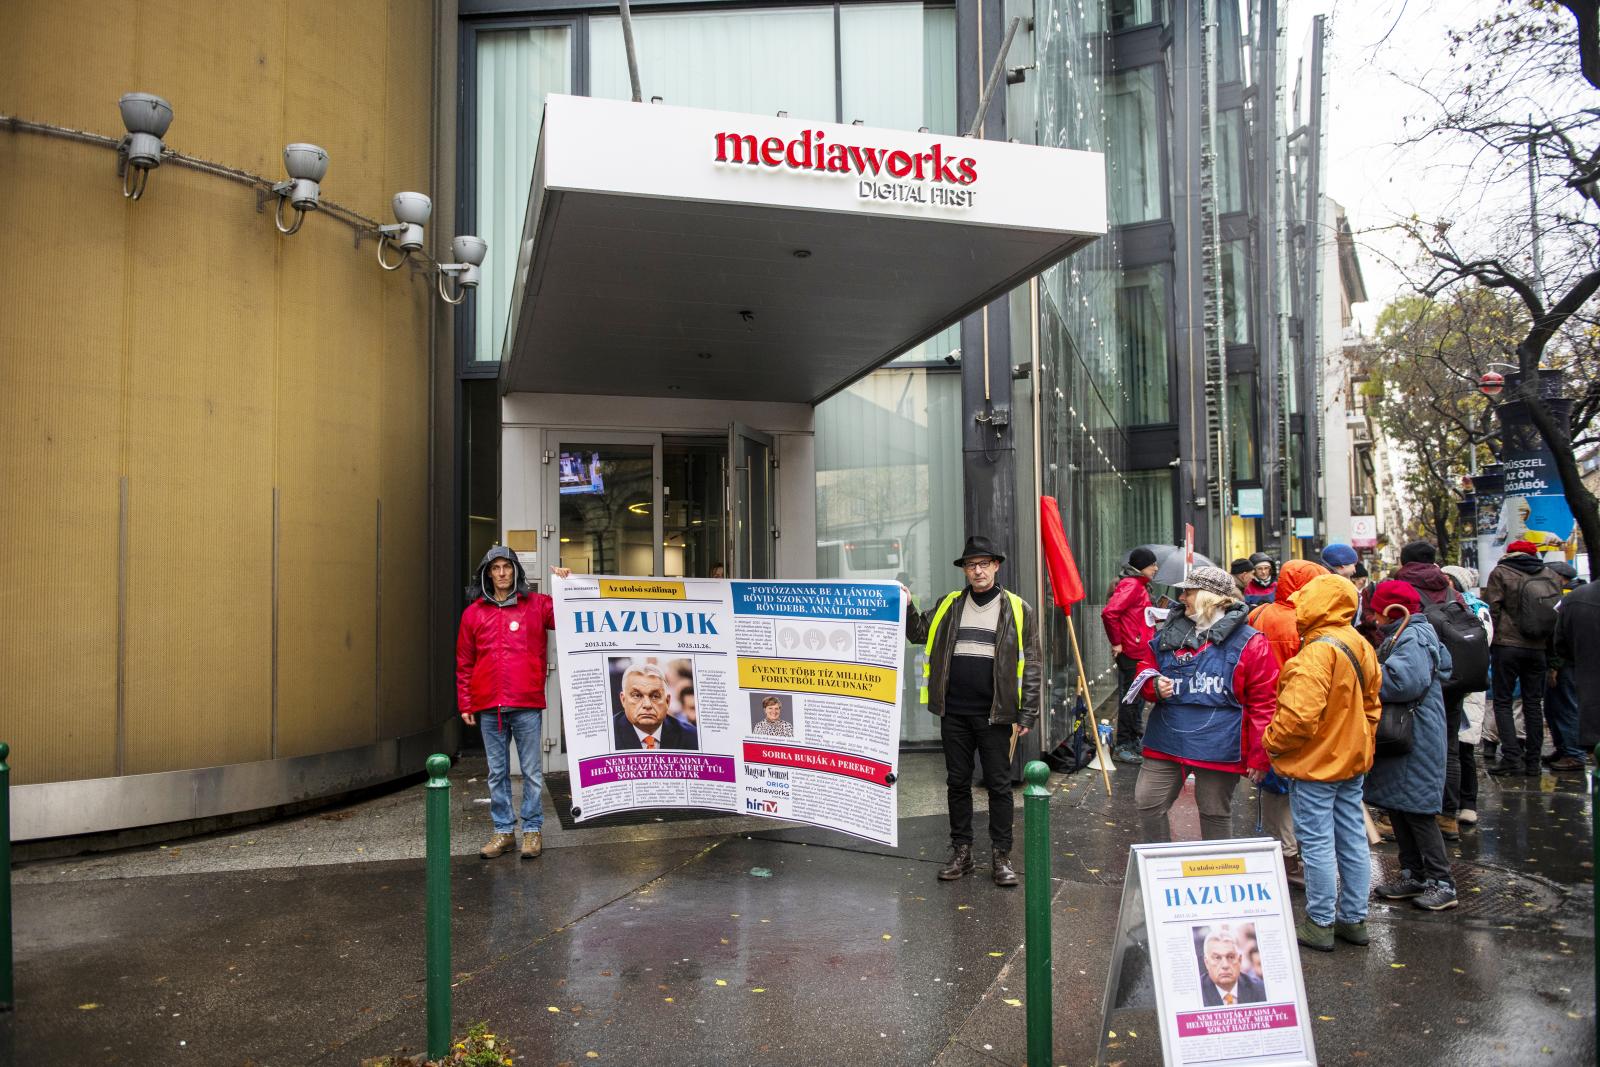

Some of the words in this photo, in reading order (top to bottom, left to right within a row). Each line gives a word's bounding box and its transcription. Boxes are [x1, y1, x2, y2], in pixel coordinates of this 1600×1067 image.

[714, 129, 978, 185] mediaworks
[858, 181, 927, 204] DIGITAL
[930, 187, 977, 207] FIRST
[1506, 472, 1516, 480] AZ
[1517, 469, 1535, 479] ÖN
[619, 585, 643, 593] utolsó
[644, 586, 677, 595] szülinap
[819, 587, 832, 596] BE
[834, 588, 841, 596] A
[843, 586, 883, 598] LÁNYOK
[743, 593, 775, 603] RÖVID
[776, 594, 830, 606] SZOKNYÁJA
[857, 597, 889, 608] MINÉL
[811, 604, 843, 615] ANNÁL
[573, 610, 719, 635] HAZUDIK
[751, 664, 788, 675] ÉVENTE
[790, 665, 816, 677] TÖBB
[818, 667, 834, 678] TÍZ
[836, 669, 882, 683] MILLIÁRD
[761, 674, 815, 686] FORINTBÓL
[817, 678, 873, 691] HAZUDNAK?
[605, 758, 626, 767] NEM
[628, 755, 666, 765] TUDTÁK
[668, 756, 701, 765] LEADNI
[702, 758, 709, 766] A
[762, 749, 793, 761] SORRA
[794, 753, 828, 765] BUKJÁK
[830, 758, 837, 767] A
[838, 760, 876, 776] PEREKET
[617, 771, 649, 780] SOKAT
[651, 770, 700, 779] HAZUDTAK
[679, 764, 705, 772] MERT
[706, 765, 725, 774] TÚL
[744, 765, 766, 779] Magyar
[767, 768, 790, 781] Nemzet
[766, 780, 790, 789] ORIGO
[745, 785, 790, 797] mediaworks
[1165, 882, 1272, 907] HAZUDIK
[1197, 1013, 1213, 1021] NEM
[1214, 1009, 1243, 1020] TUDTÁK
[1244, 1009, 1270, 1017] LEADNI
[1254, 1015, 1273, 1024] MERT
[1207, 1025, 1231, 1034] SOKAT
[1232, 1021, 1271, 1032] HAZUDTAK
